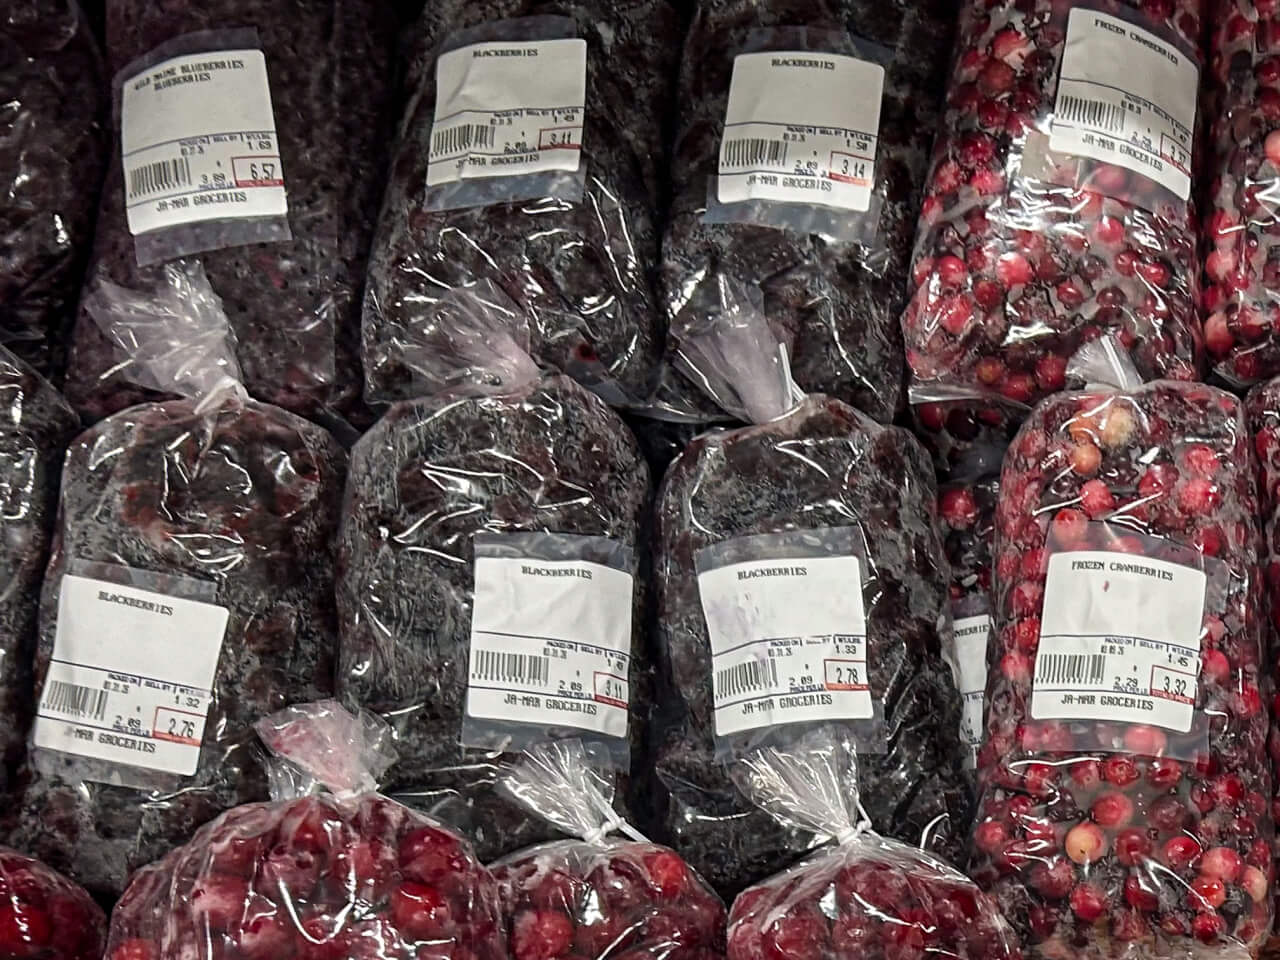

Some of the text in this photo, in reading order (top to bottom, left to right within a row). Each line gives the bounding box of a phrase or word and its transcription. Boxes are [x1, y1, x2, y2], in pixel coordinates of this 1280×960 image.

[1094, 19, 1126, 38] FROZEN
[772, 59, 835, 70] BLACKBERRIES
[1119, 145, 1163, 171] GROCERIES
[747, 176, 832, 192] JA-MAR GROCERIES
[156, 191, 247, 213] JA-MAR GROCERIES
[521, 566, 592, 580] BLACKBERRIES
[738, 567, 807, 580] BLACKBERRIES
[1070, 560, 1172, 581] FROZEN CRANBERRIES
[98, 590, 173, 617] BLACKBERRIES
[503, 692, 597, 715] JA-MAR GROCERIES
[742, 694, 832, 715] JA-MAR GROCERIES
[1060, 695, 1152, 710] JA-MAR GROCERIES
[98, 735, 156, 754] GROCERIES
